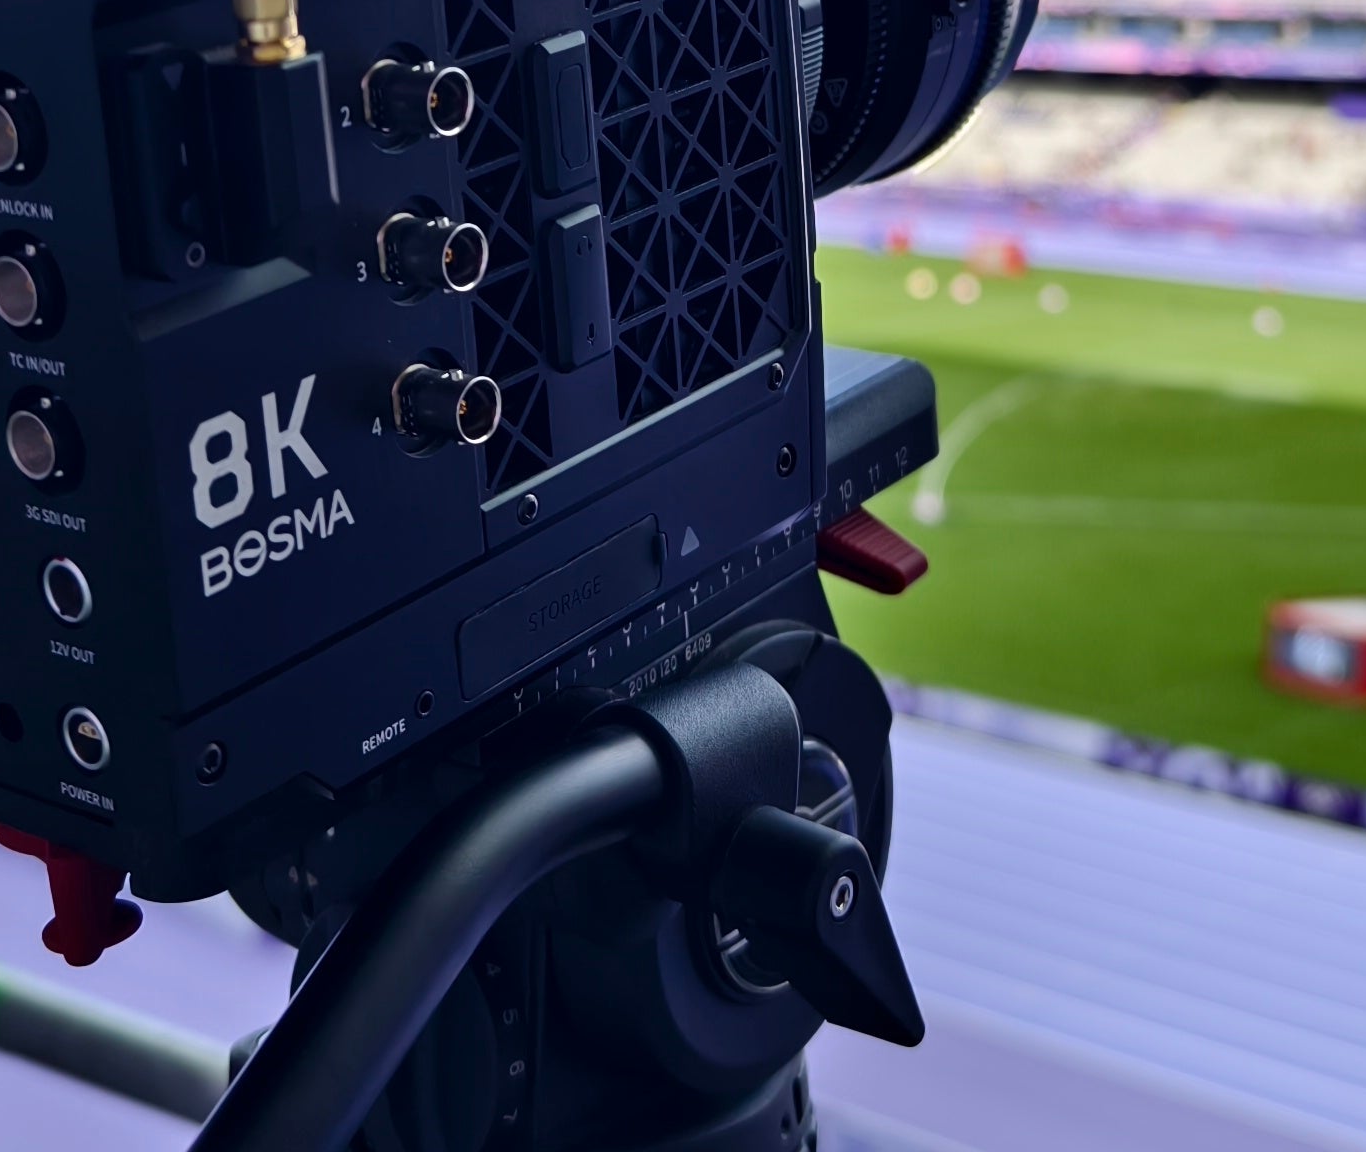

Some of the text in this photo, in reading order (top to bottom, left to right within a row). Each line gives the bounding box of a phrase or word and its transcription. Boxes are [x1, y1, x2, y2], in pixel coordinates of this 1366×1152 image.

[341, 106, 352, 128] 2
[40, 206, 53, 221] IN
[357, 261, 367, 282] 3
[9, 351, 66, 377] TC IN/OUT
[371, 416, 382, 437] 4
[189, 373, 328, 529] 8K
[839, 479, 853, 503] 10
[25, 504, 86, 532] 3G SDI OUT
[200, 489, 355, 597] BOSMA
[528, 575, 601, 632] STORAGE
[50, 641, 94, 664] 12V OUT
[628, 667, 657, 697] 2010
[362, 719, 406, 754] REMOTE
[60, 781, 114, 812] POWER IN
